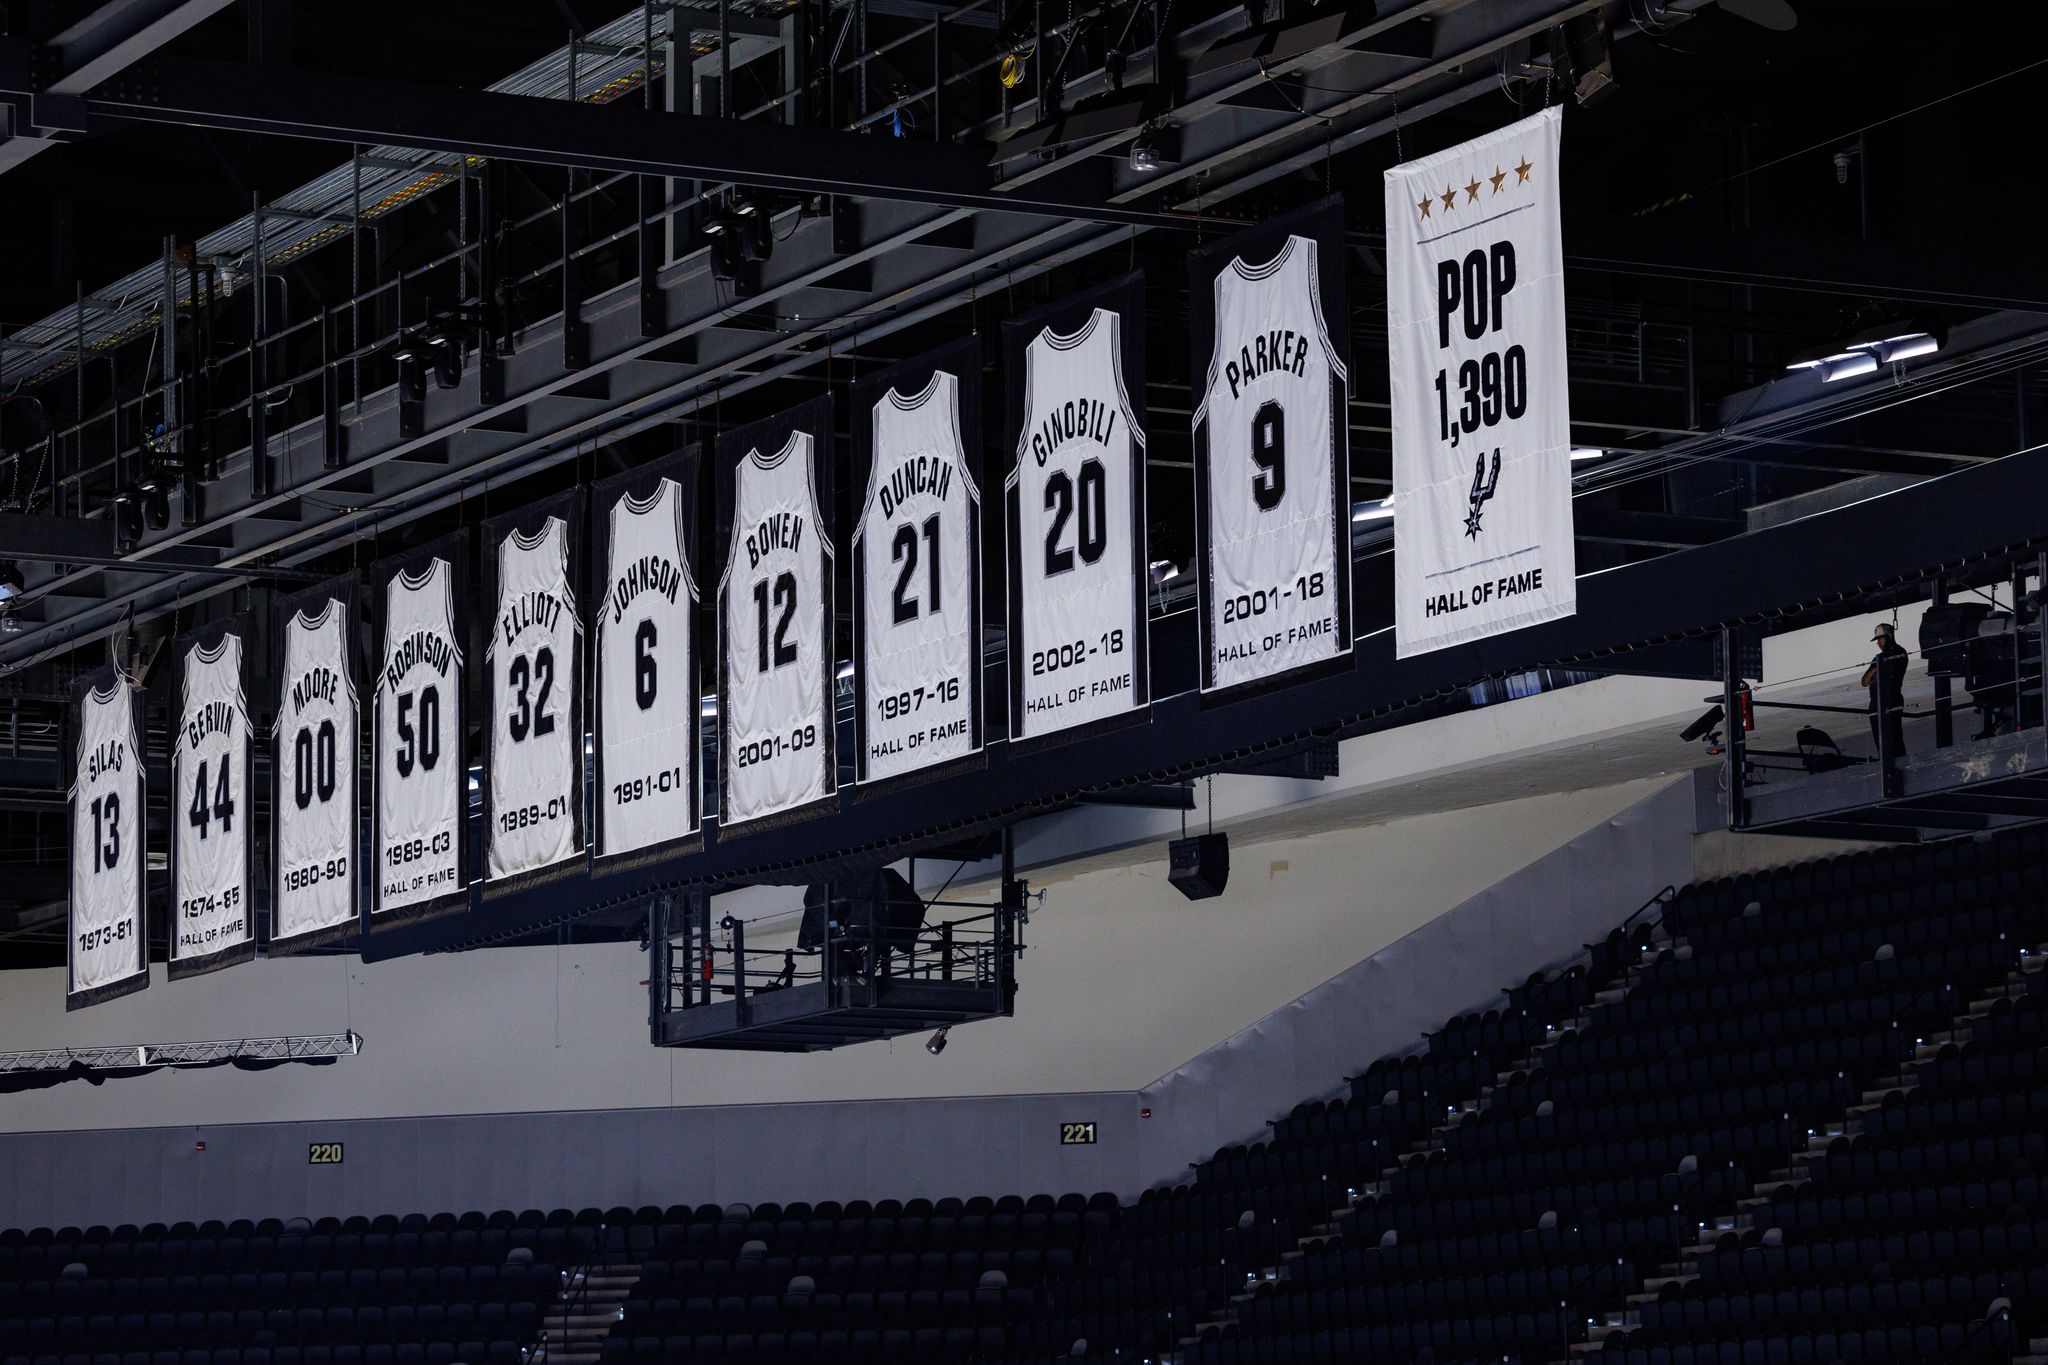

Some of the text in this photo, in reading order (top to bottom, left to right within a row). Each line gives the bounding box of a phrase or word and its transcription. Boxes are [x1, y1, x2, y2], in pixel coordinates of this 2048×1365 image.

[1437, 240, 1517, 350] POP
[1225, 329, 1309, 401] PARKER
[1435, 344, 1527, 449] 1,390
[1032, 398, 1116, 468] GINOBILI
[1250, 398, 1286, 513] 9
[879, 455, 953, 521] DUNCAN
[745, 512, 803, 571] BOWEN
[1044, 457, 1107, 578] 20
[612, 555, 681, 625] JOHNSON
[891, 511, 941, 625] 21
[1425, 568, 1543, 618] HALL OF FAME
[502, 591, 562, 648] ELLIOTT
[753, 571, 798, 673] 12
[1223, 572, 1324, 625] 2001-18
[386, 630, 452, 695] ROBINSON
[635, 618, 658, 711] 6
[1032, 629, 1124, 677] 2002-18
[1218, 617, 1332, 664] HALL OF FAME
[292, 667, 338, 717] MOORE
[509, 646, 555, 743] 32
[877, 677, 959, 722] 1997-16
[1026, 673, 1131, 715] HALL OF FAME
[188, 701, 235, 750] GERVIN
[396, 684, 440, 779] 50
[738, 724, 816, 769] 2001-09
[871, 719, 967, 760] HALL OF FAME
[89, 739, 124, 783] SILAS
[295, 719, 336, 811] 00
[613, 767, 680, 805] 1991-01
[188, 752, 235, 840] 44
[500, 795, 566, 833] 1989-01
[90, 791, 120, 875] 13
[385, 831, 450, 867] 1989-03
[284, 857, 347, 892] 1980-90
[383, 867, 455, 898] HALL OF FAME
[182, 885, 240, 919] 1974-85
[78, 918, 132, 952] 1973-81
[205, 928, 217, 942] OF
[310, 1144, 342, 1163] 220
[1063, 1124, 1094, 1143] 221
